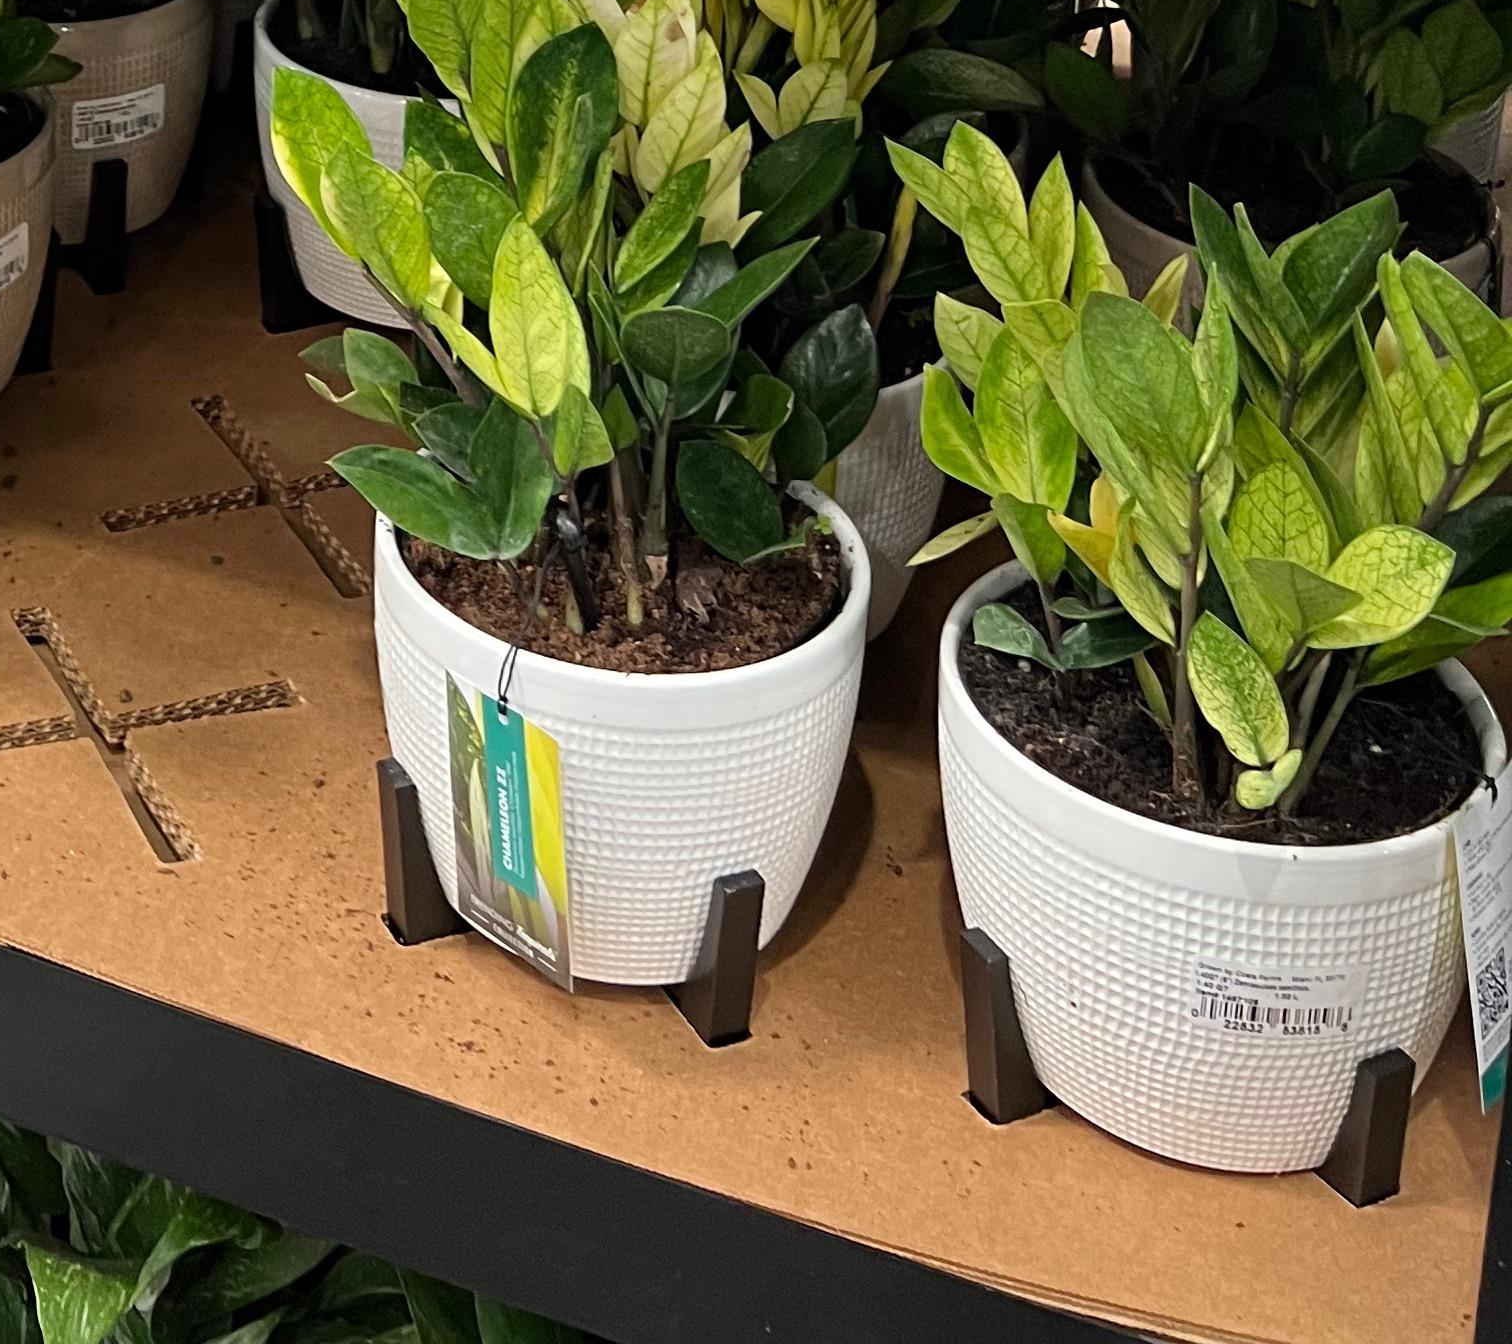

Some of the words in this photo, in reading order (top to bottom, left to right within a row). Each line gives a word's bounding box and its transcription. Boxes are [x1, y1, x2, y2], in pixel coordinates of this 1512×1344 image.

[496, 787, 512, 871] CHAMELEON
[1191, 1008, 1199, 1017] 0
[1224, 1019, 1264, 1034] 22532
